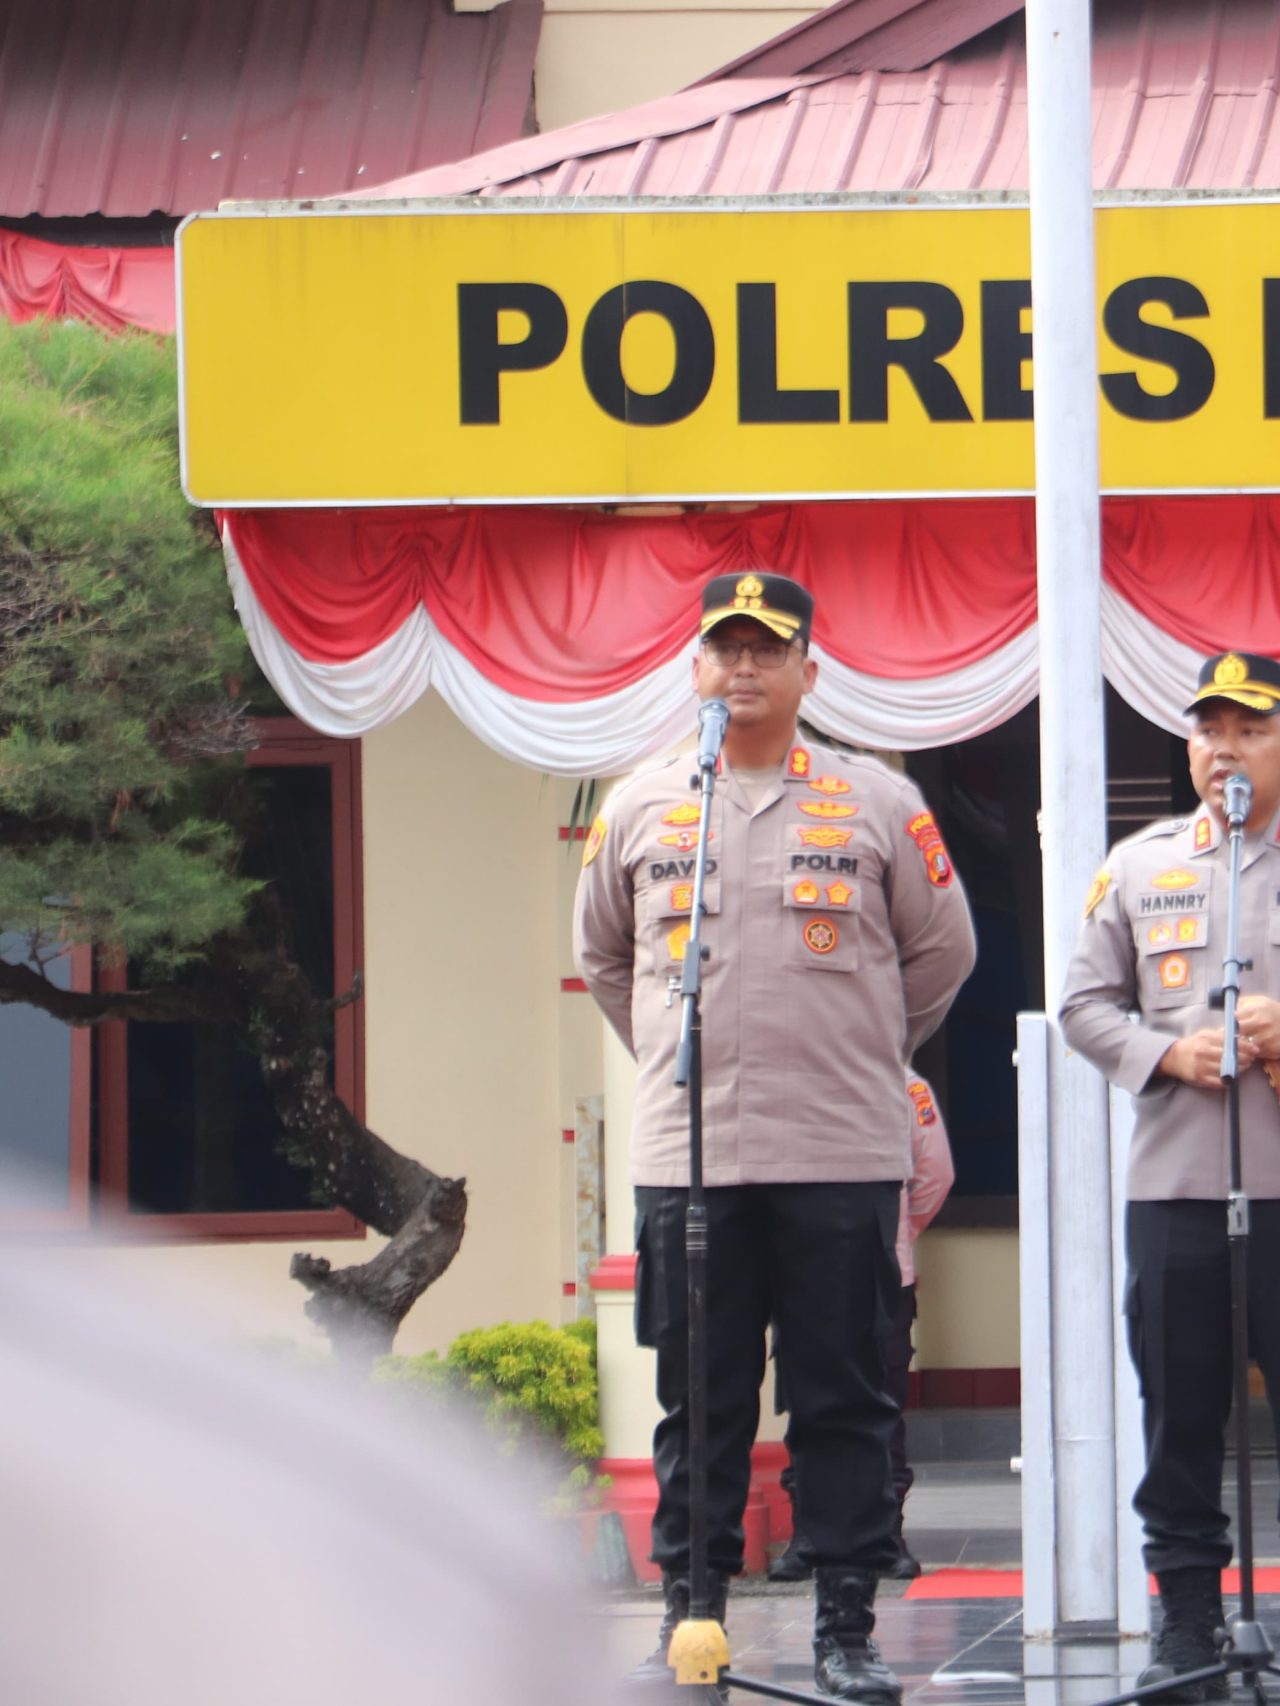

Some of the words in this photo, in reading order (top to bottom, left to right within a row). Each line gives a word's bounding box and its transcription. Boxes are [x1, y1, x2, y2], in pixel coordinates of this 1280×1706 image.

[650, 859, 718, 880] DAVD
[791, 854, 859, 875] POLRI
[1140, 893, 1206, 914] HANNRY
